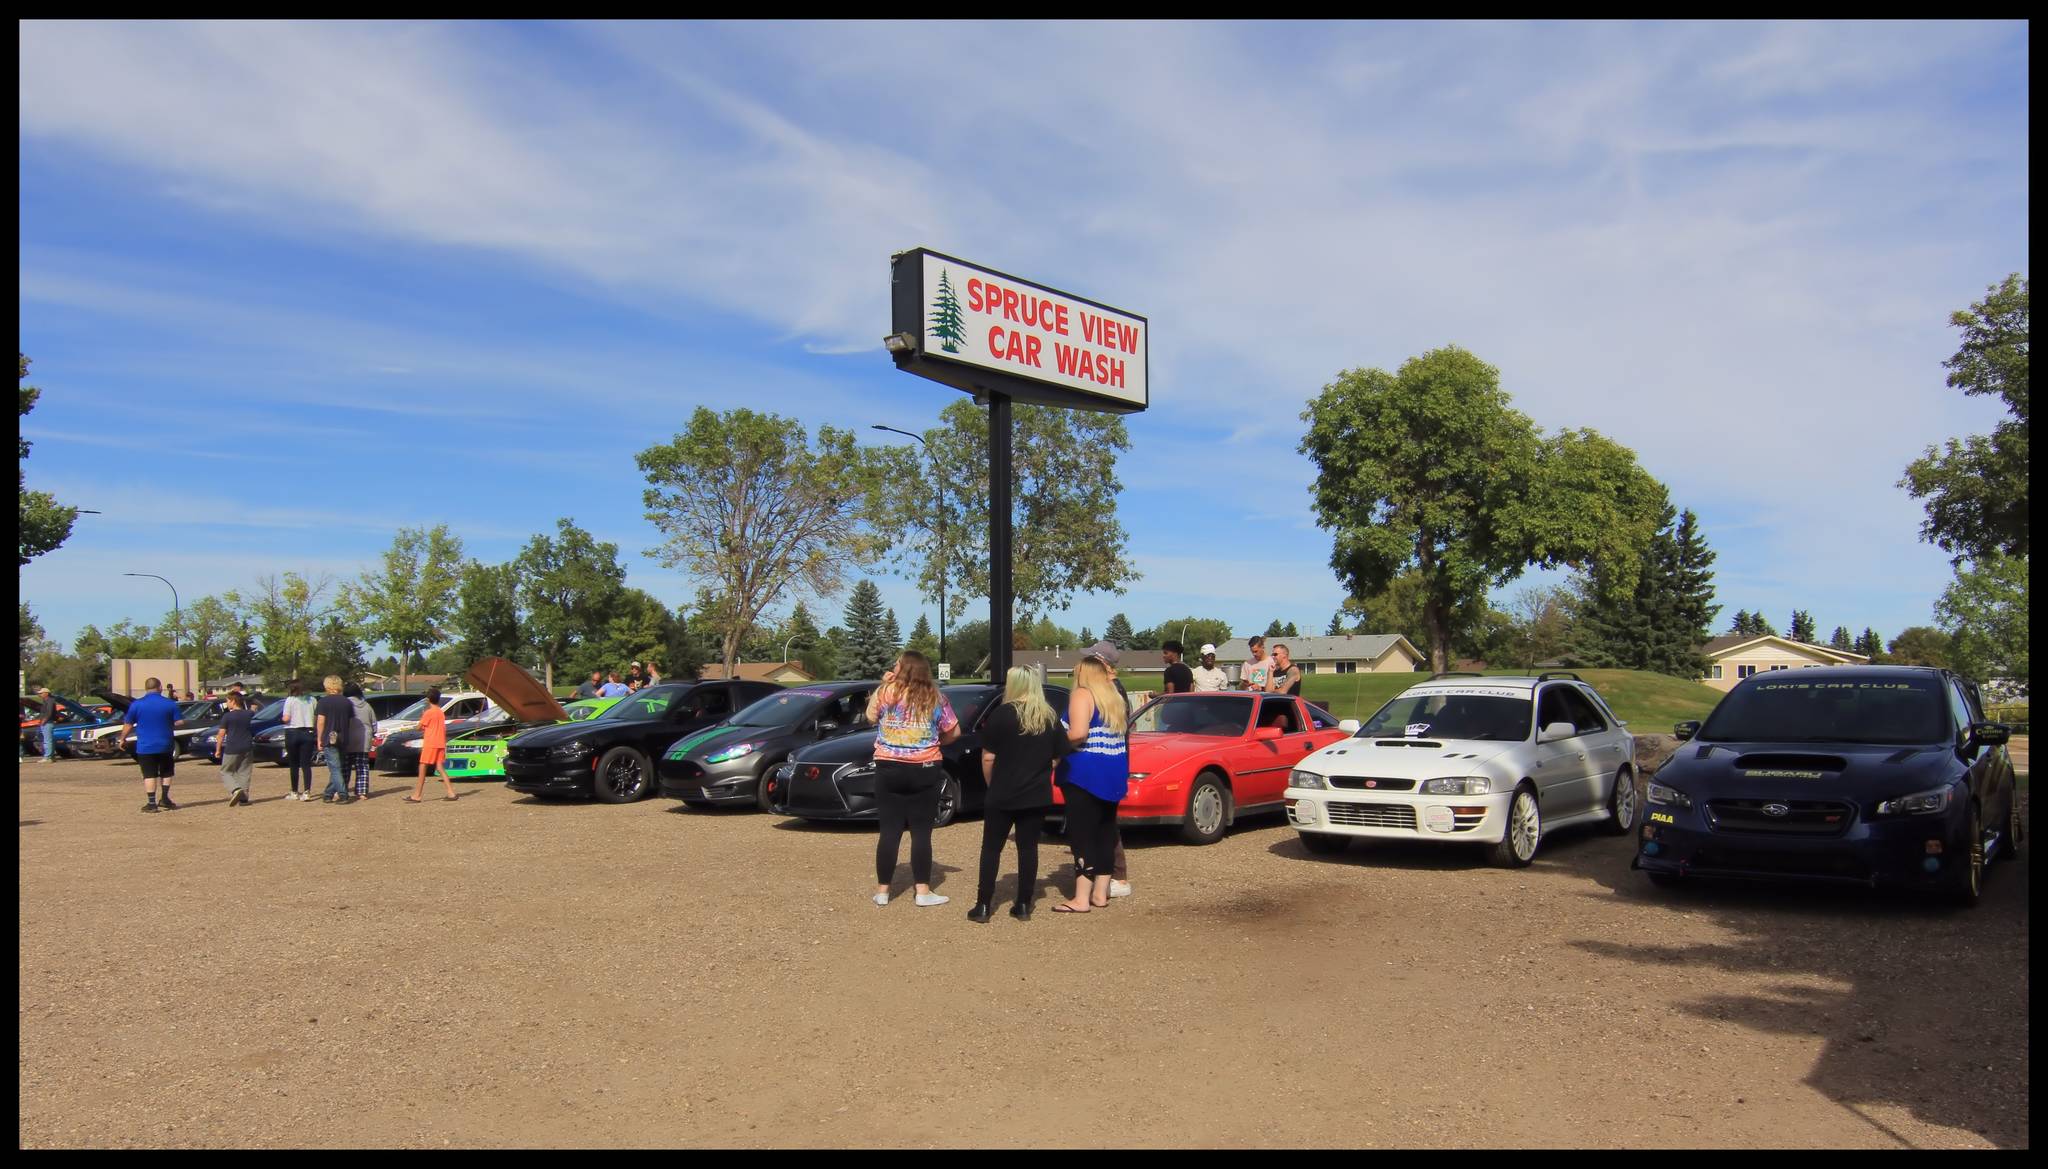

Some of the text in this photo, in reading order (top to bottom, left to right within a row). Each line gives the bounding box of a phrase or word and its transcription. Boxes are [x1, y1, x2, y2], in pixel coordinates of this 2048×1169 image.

[967, 278, 1139, 355] SPRUCE VIEW
[988, 325, 1125, 389] CAR WASH
[940, 670, 949, 678] 60
[1756, 683, 1810, 691] LOKI'S
[1479, 689, 1516, 697] CLUB
[1744, 769, 1822, 779] SUBARU
[1650, 812, 1674, 824] PIAA
